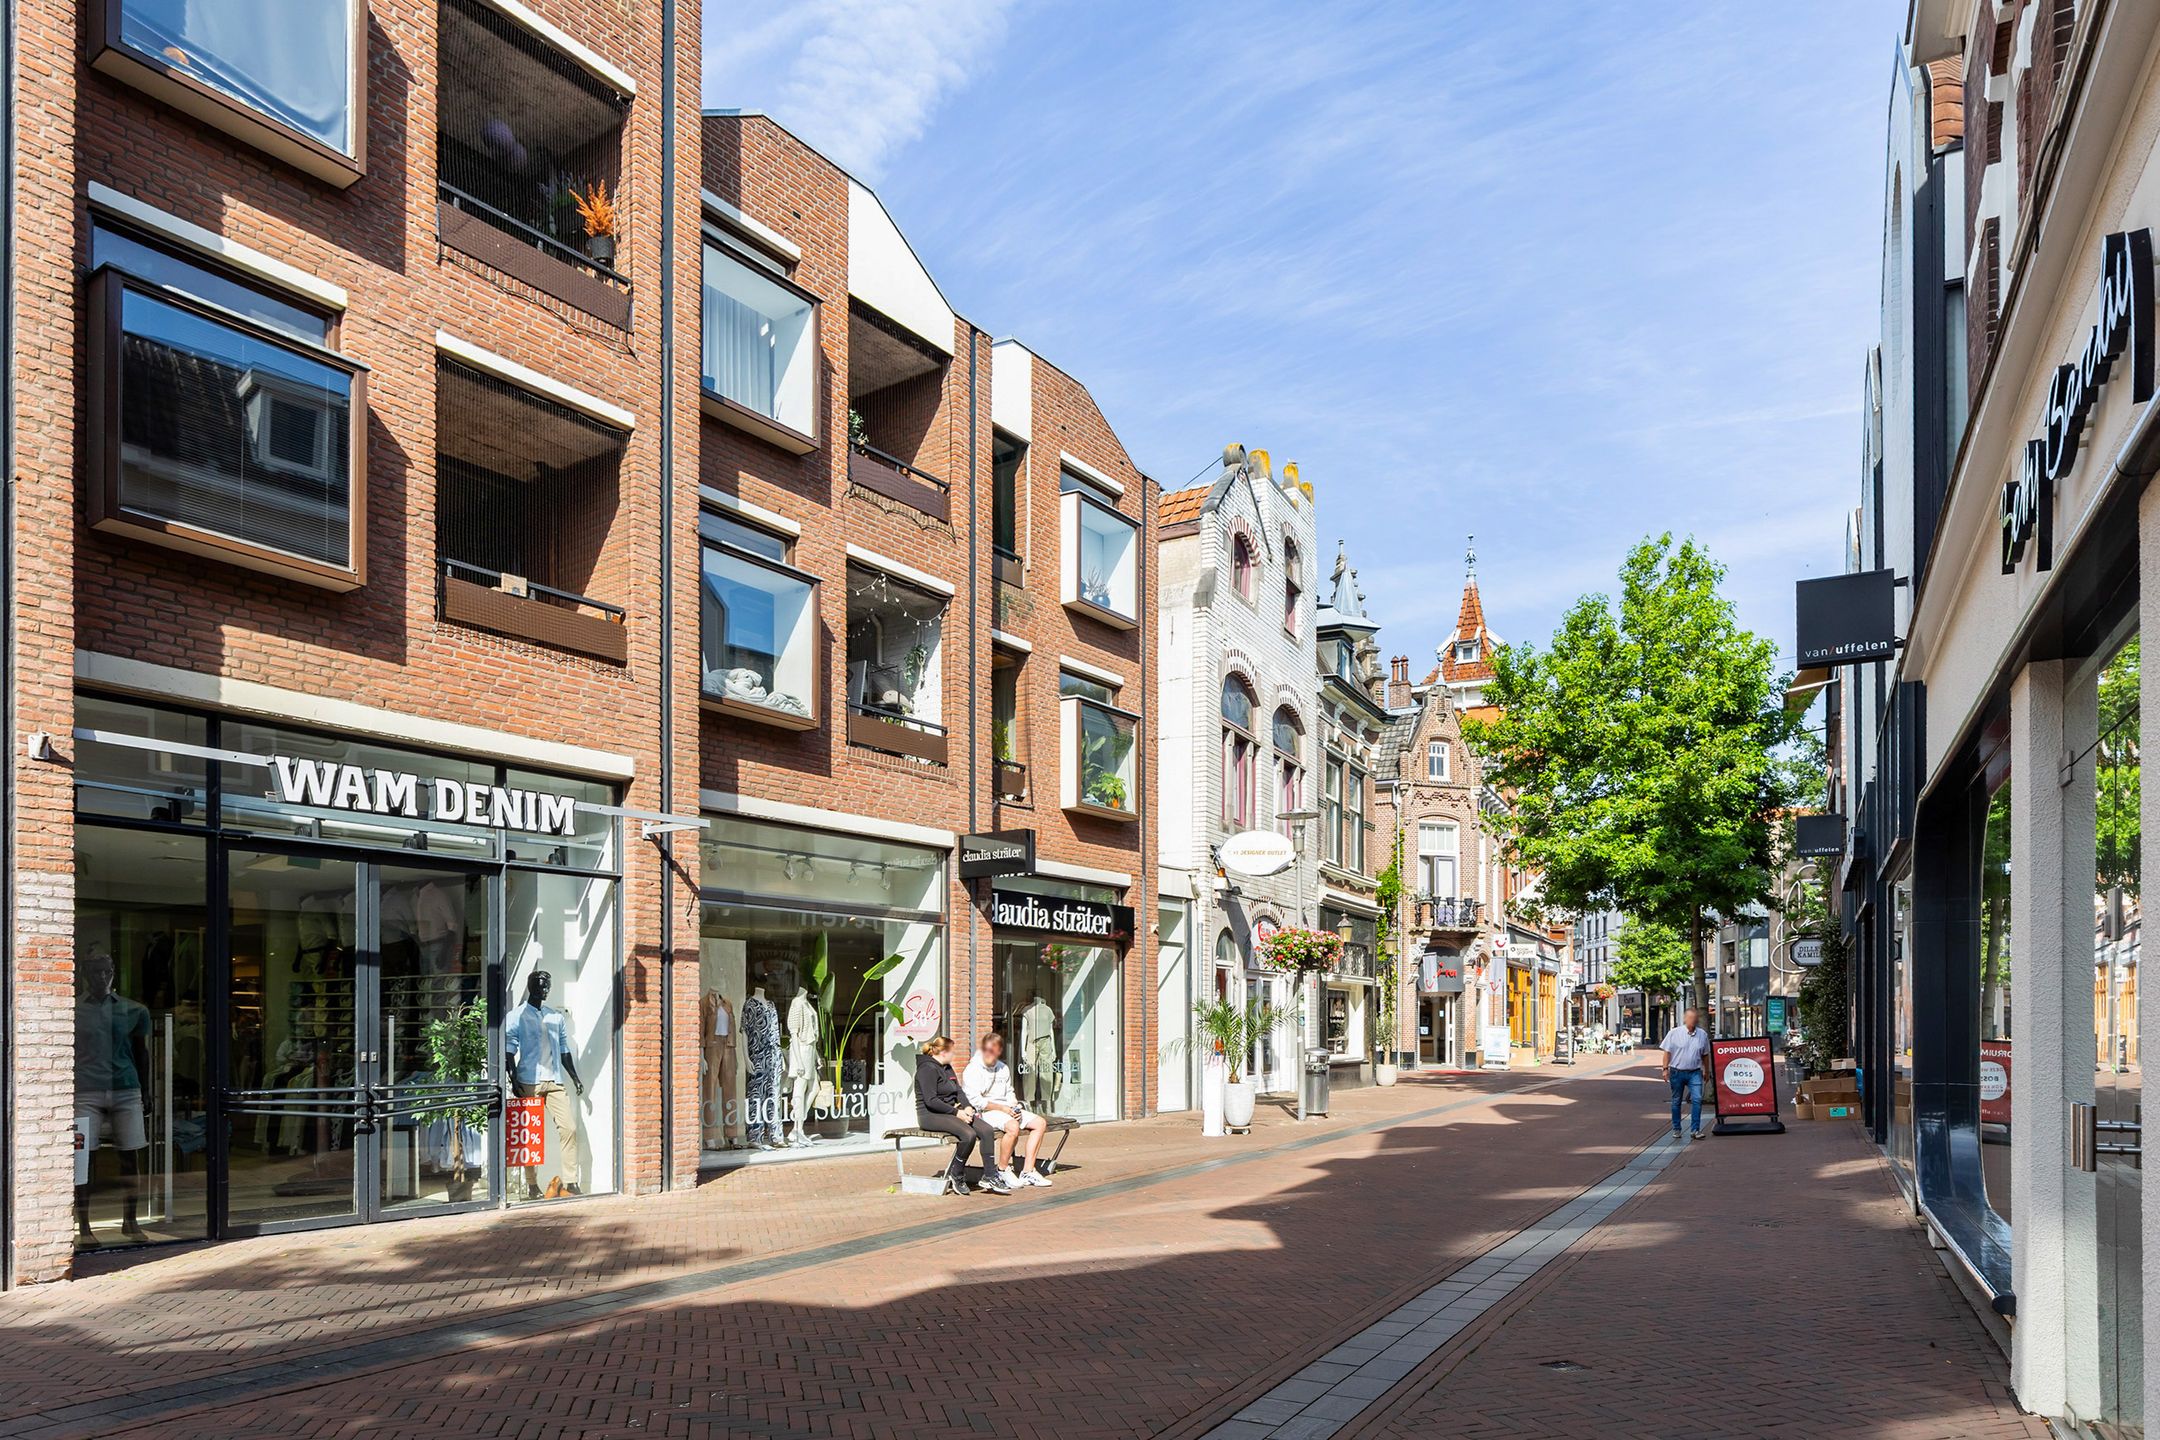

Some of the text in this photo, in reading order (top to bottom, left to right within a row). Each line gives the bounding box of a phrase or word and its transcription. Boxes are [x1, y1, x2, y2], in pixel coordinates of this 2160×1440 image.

[268, 754, 577, 836] WAM DENIM
[962, 847, 1022, 862] claudia sträter
[1053, 904, 1112, 935] sträter
[1717, 1045, 1766, 1055] OPRUIMING
